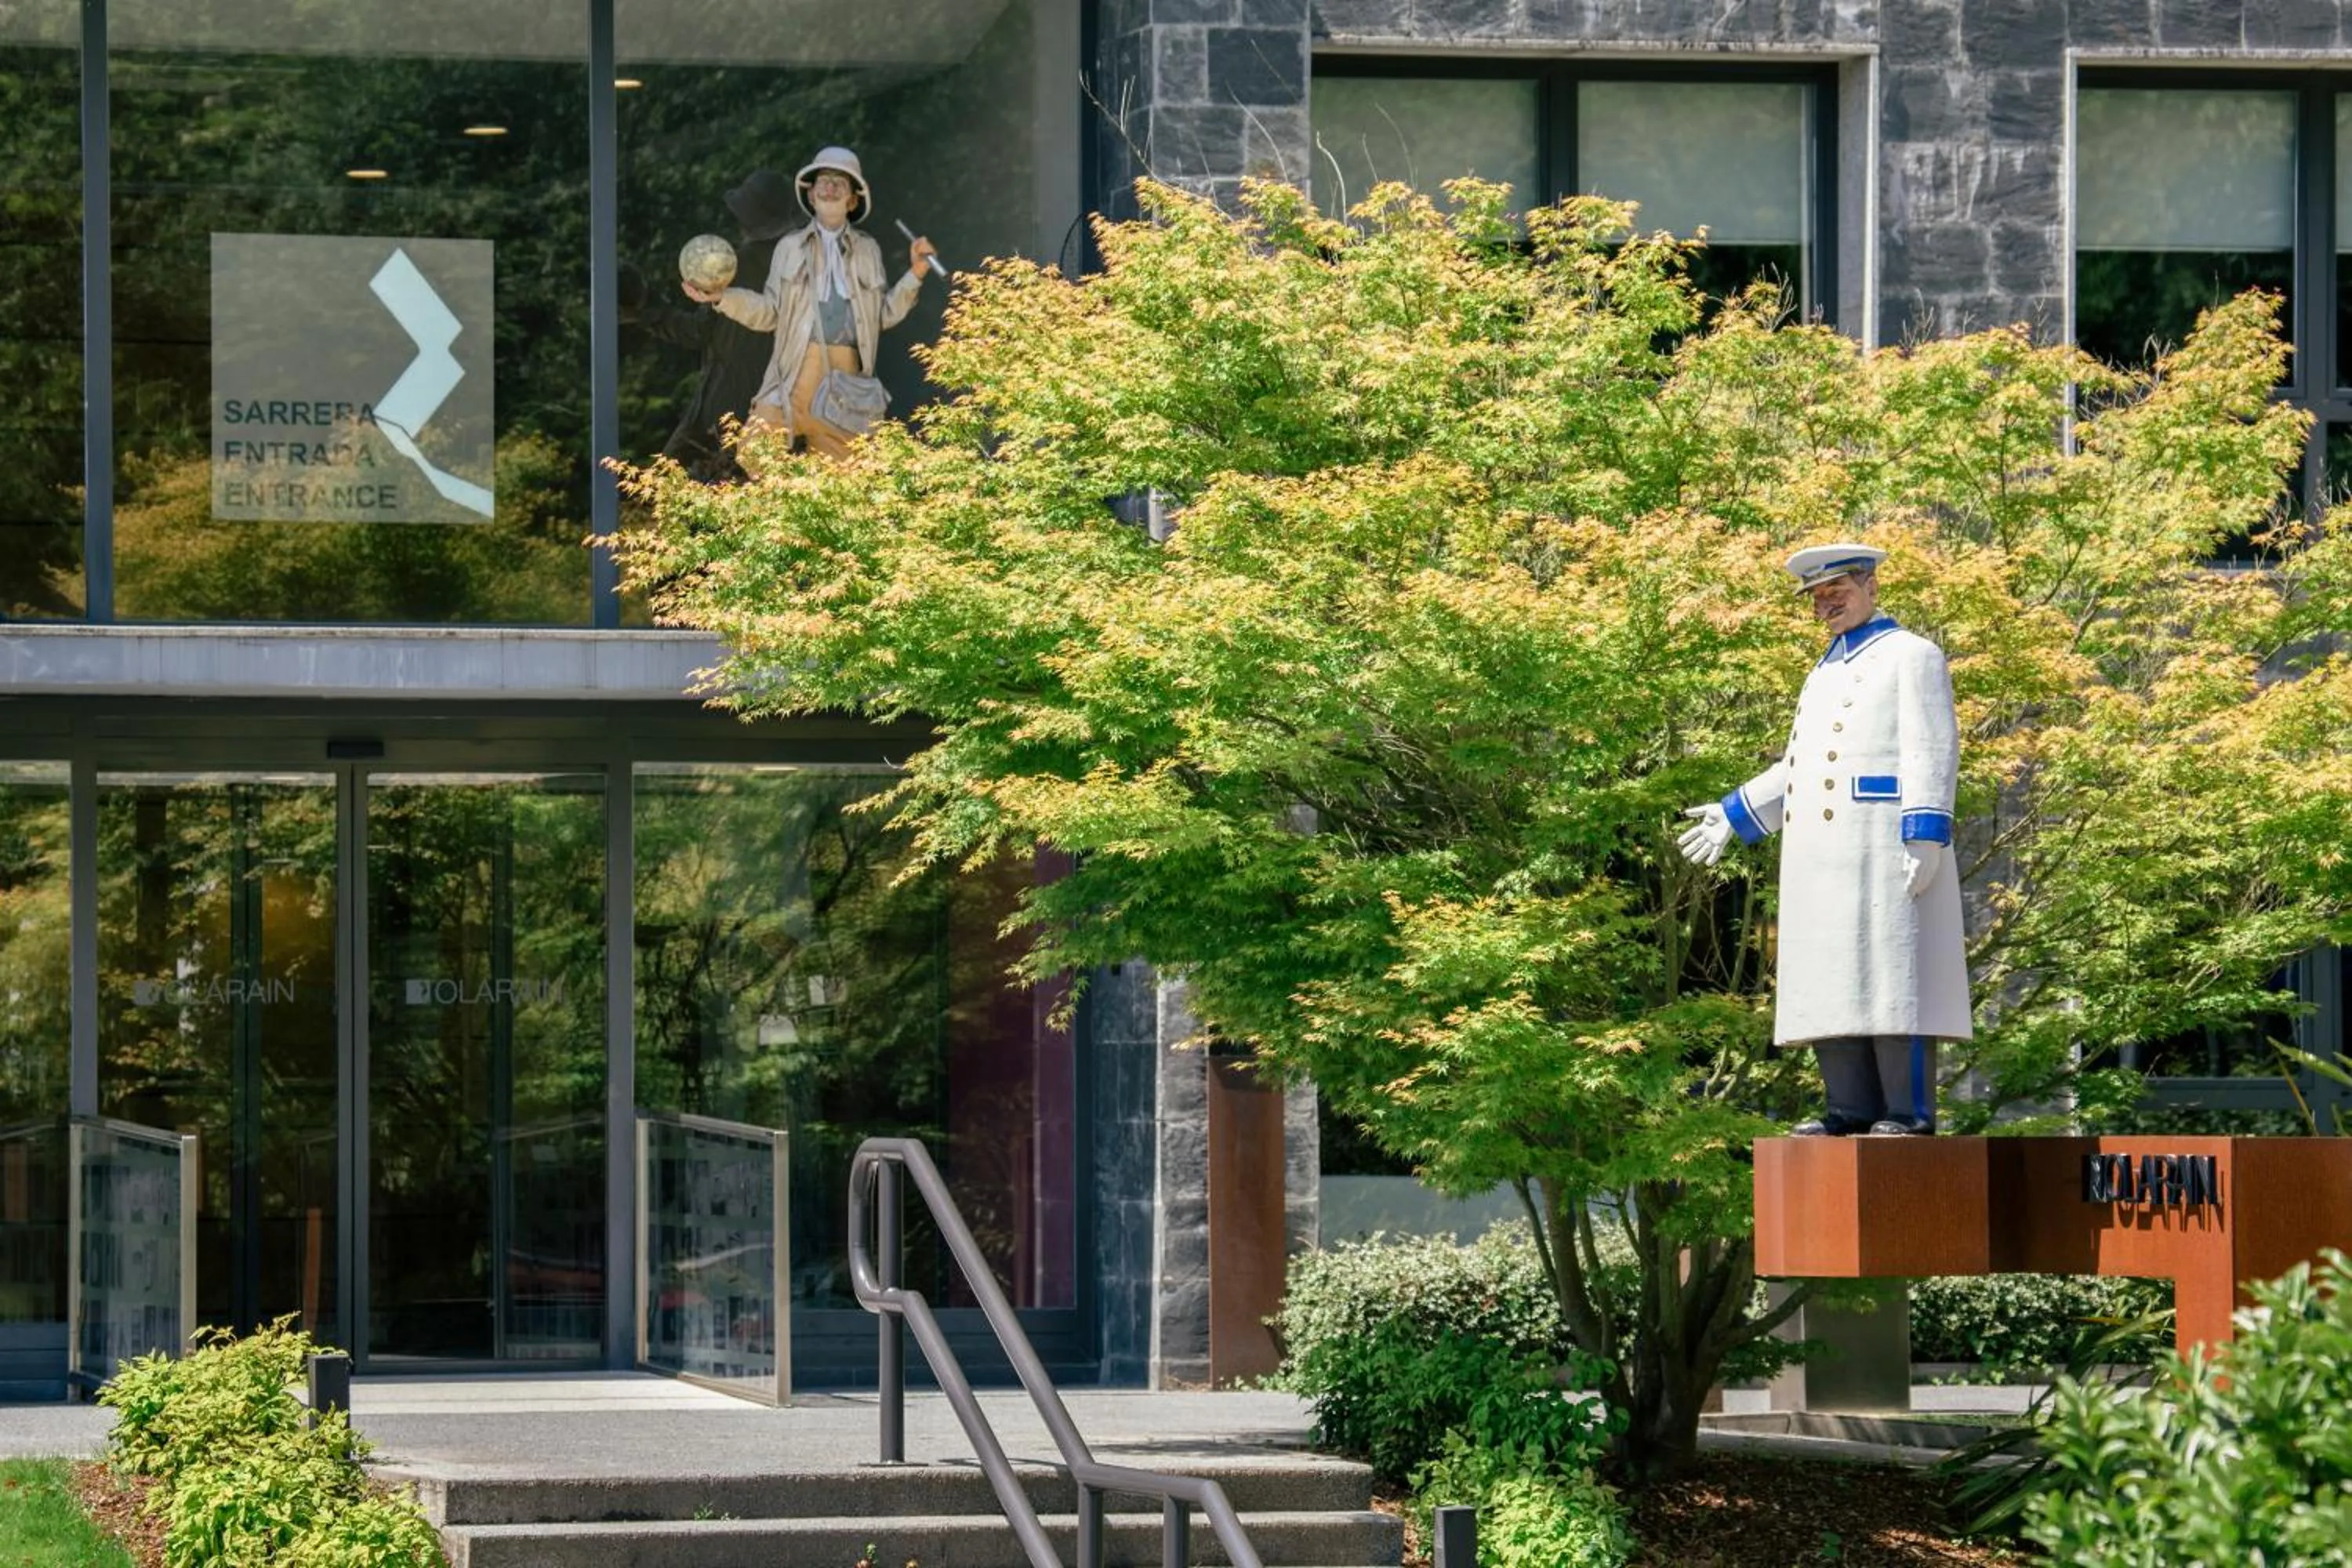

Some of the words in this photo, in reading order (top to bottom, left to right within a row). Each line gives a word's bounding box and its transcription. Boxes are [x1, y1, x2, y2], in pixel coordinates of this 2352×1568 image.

[223, 400, 379, 426] SARRERA
[223, 441, 375, 467] ENTRADA
[223, 485, 397, 509] ENTRANCE
[164, 979, 294, 1004] OLARAIN
